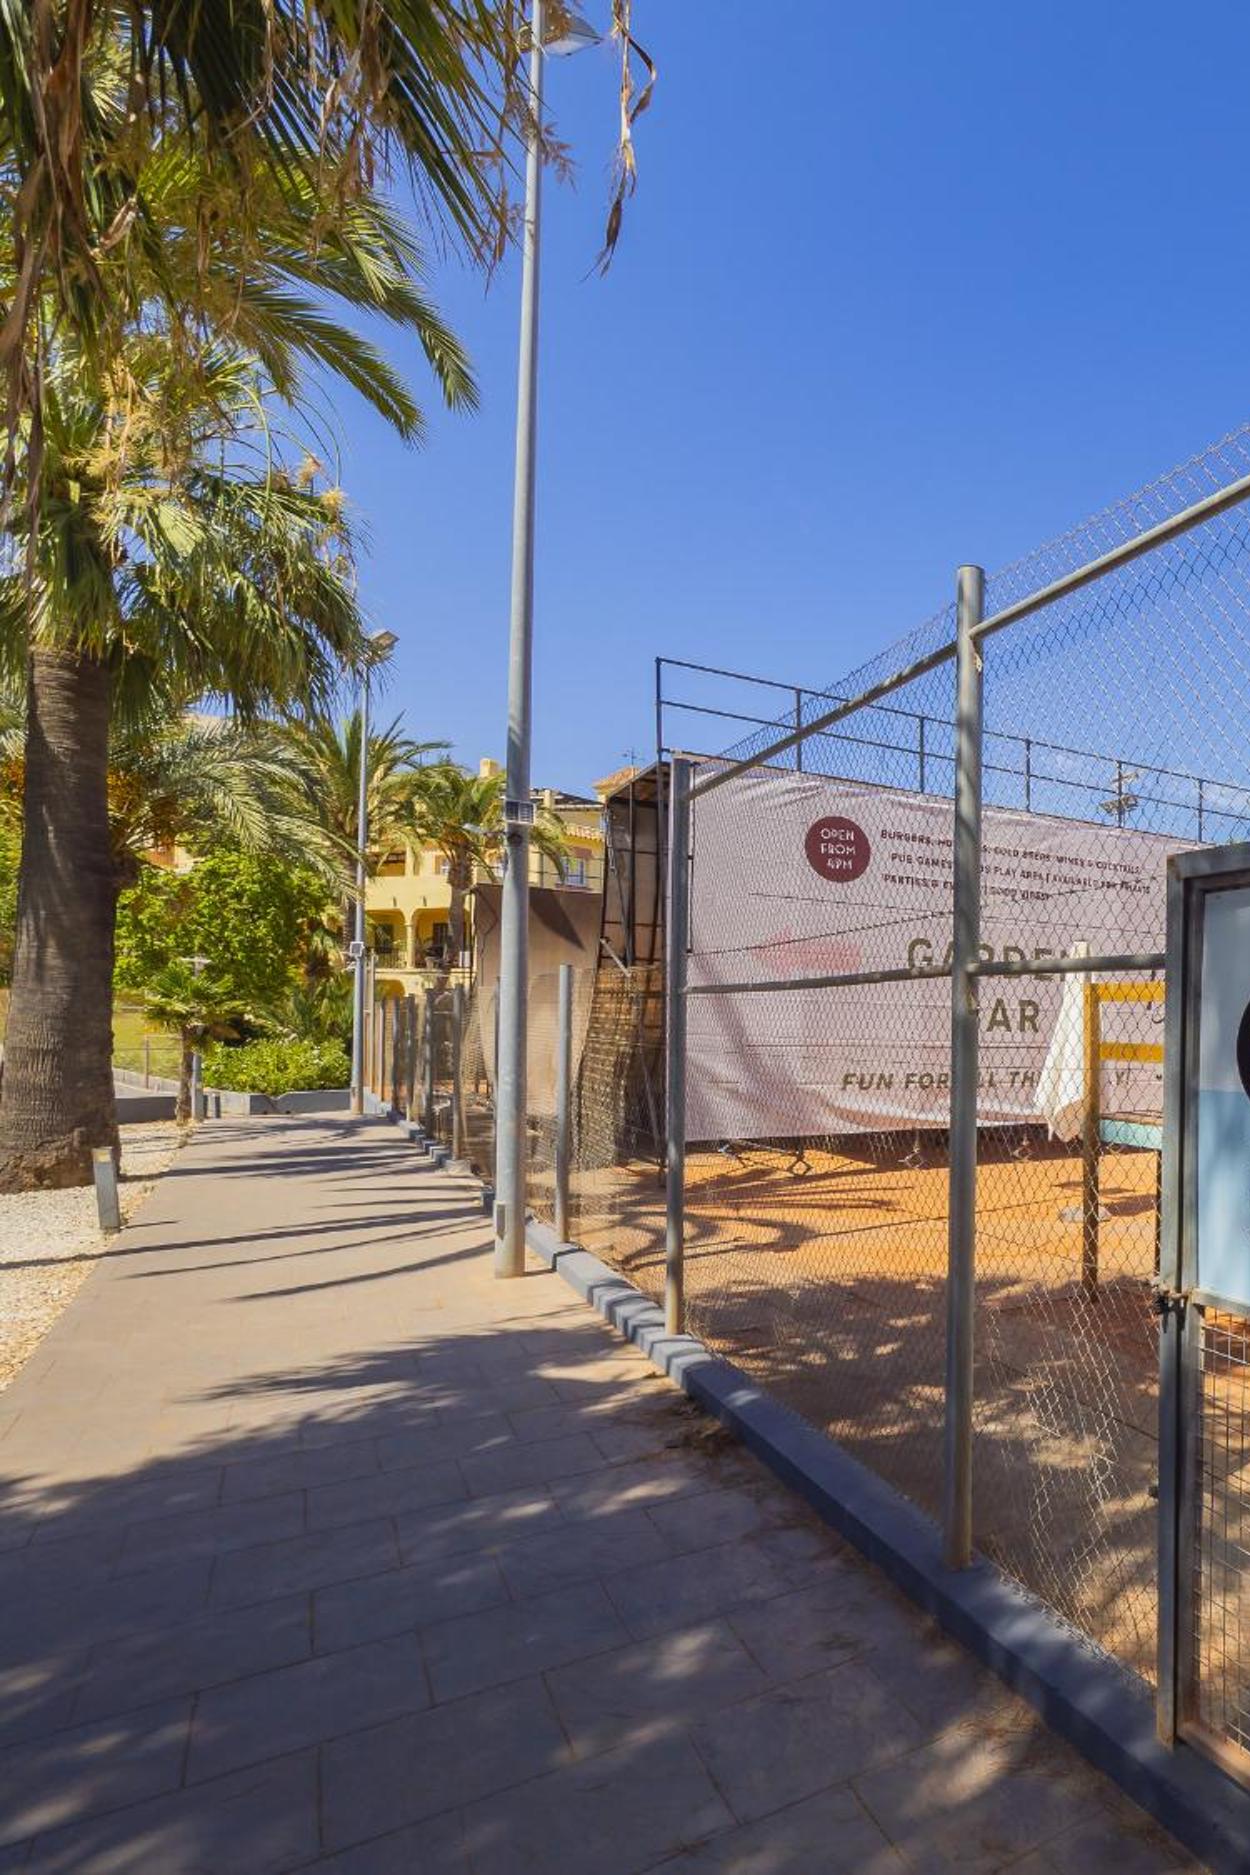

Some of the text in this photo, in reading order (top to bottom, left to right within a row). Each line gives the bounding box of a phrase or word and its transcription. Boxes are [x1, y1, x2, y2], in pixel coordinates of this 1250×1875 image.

[820, 828, 855, 841] OPEN
[820, 842, 857, 855] FROM
[907, 938, 1066, 981] GRDE
[842, 1072, 894, 1091] FUN
[904, 1072, 949, 1089] FOR
